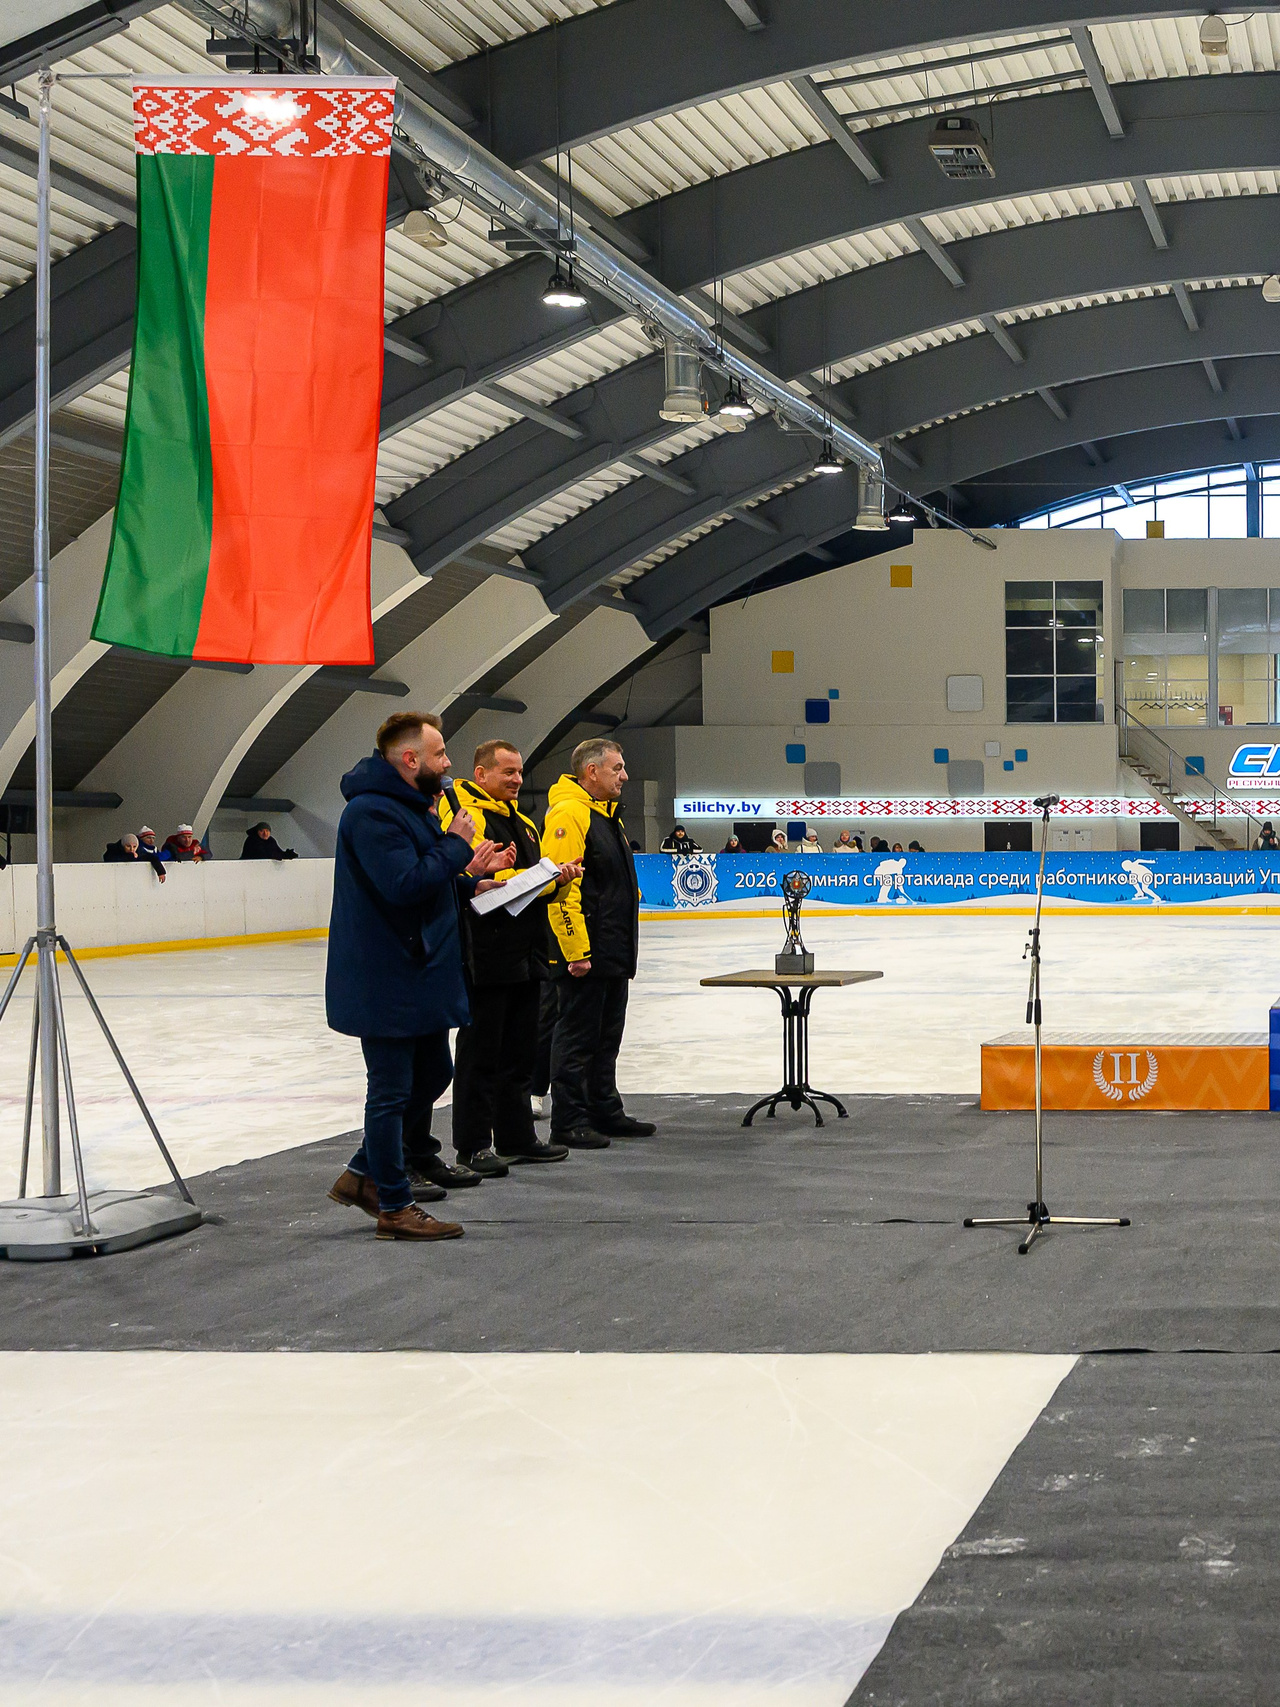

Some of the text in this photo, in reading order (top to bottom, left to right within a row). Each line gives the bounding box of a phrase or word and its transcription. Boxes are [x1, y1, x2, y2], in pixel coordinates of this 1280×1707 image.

[684, 801, 761, 815] silichy.by
[734, 872, 777, 888] 2026
[863, 873, 974, 889] спартакиада
[978, 873, 1031, 889] среди
[1035, 867, 1138, 888] работников
[1142, 869, 1255, 888] организаций
[1110, 1052, 1140, 1084] II
